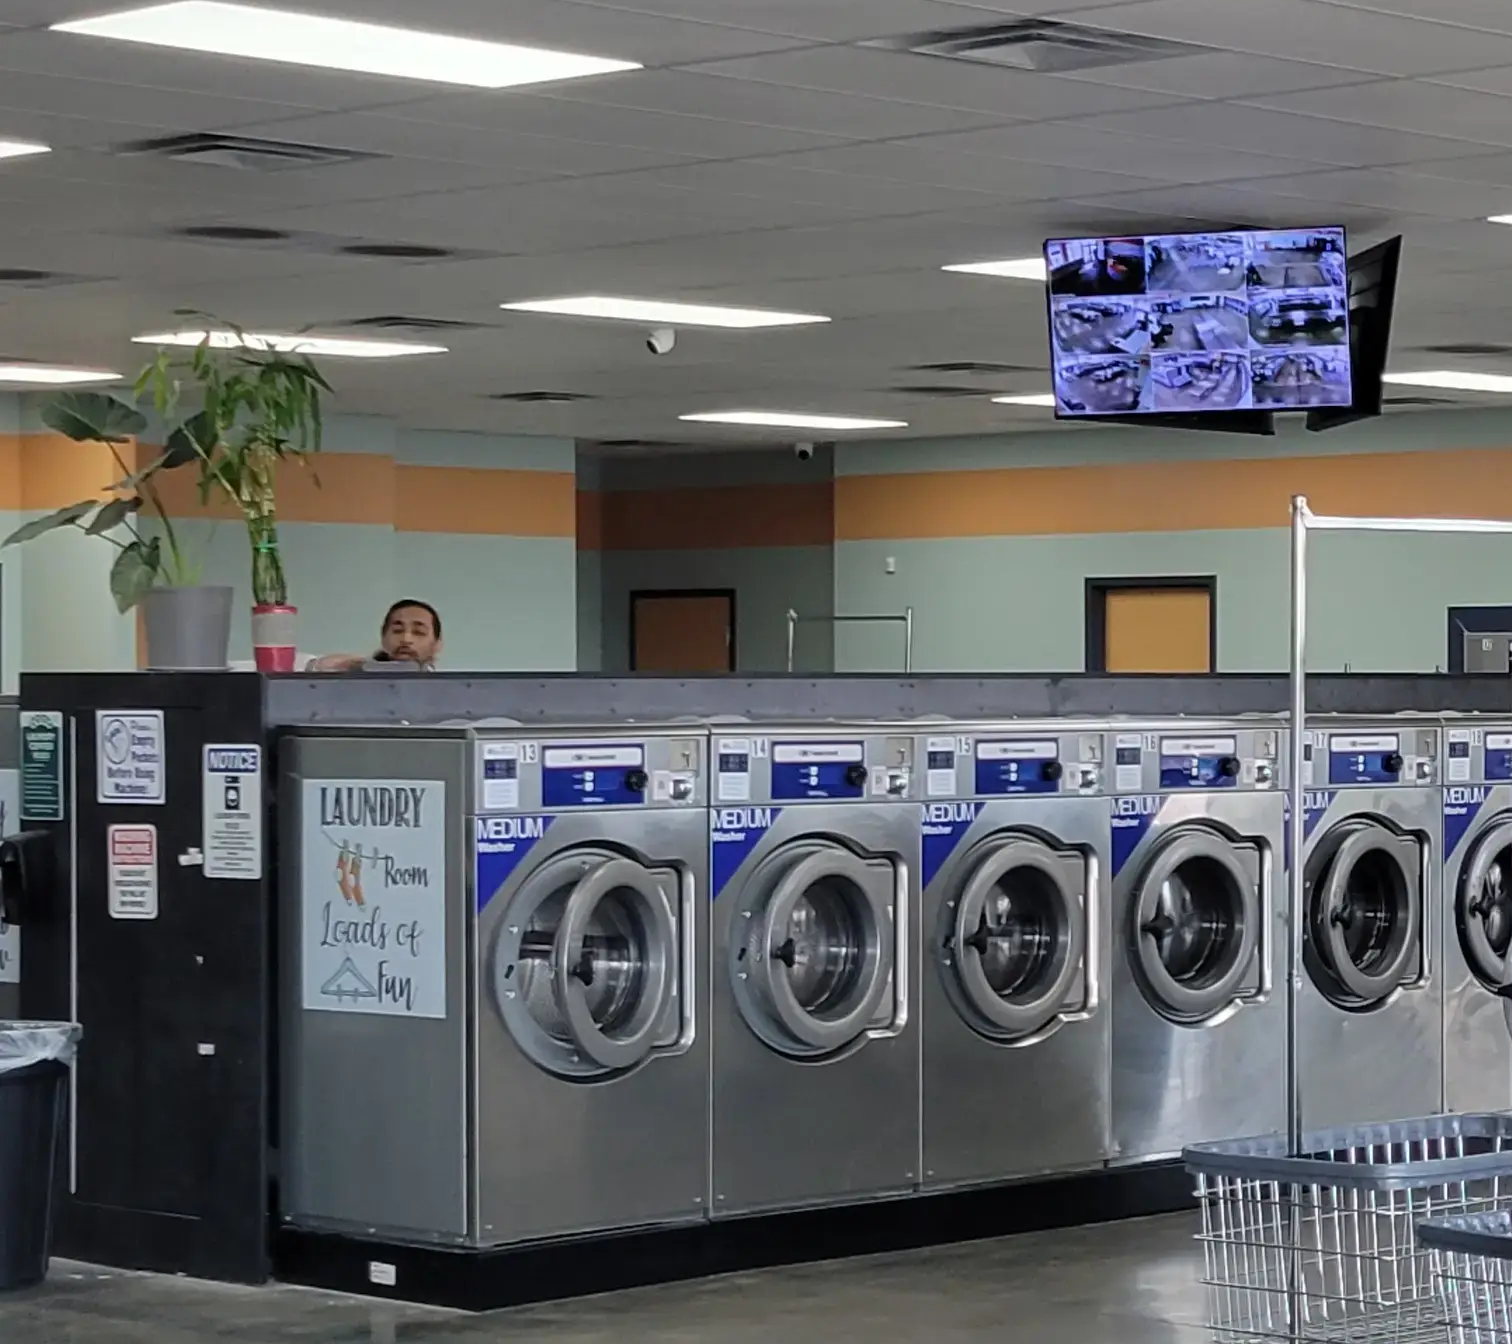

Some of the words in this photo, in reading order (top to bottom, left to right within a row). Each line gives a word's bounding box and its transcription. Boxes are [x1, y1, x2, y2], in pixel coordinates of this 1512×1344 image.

[753, 739, 767, 756] 14
[958, 738, 971, 754] 15
[1144, 735, 1157, 751] 16
[1315, 732, 1326, 748] 17
[521, 744, 537, 761] 13
[1444, 787, 1484, 804] MEDIUM
[320, 787, 426, 827] LAUNDRY
[922, 803, 975, 823] MEDIUM
[1111, 796, 1160, 816] MEDIUM
[477, 818, 544, 839] MEDIUM
[712, 809, 771, 830] MEDIUM
[712, 831, 746, 842] Washer
[477, 841, 516, 853] Washer
[385, 855, 429, 888] Room
[320, 901, 391, 950] Loads
[396, 920, 425, 957] of
[377, 960, 419, 1011] Fun
